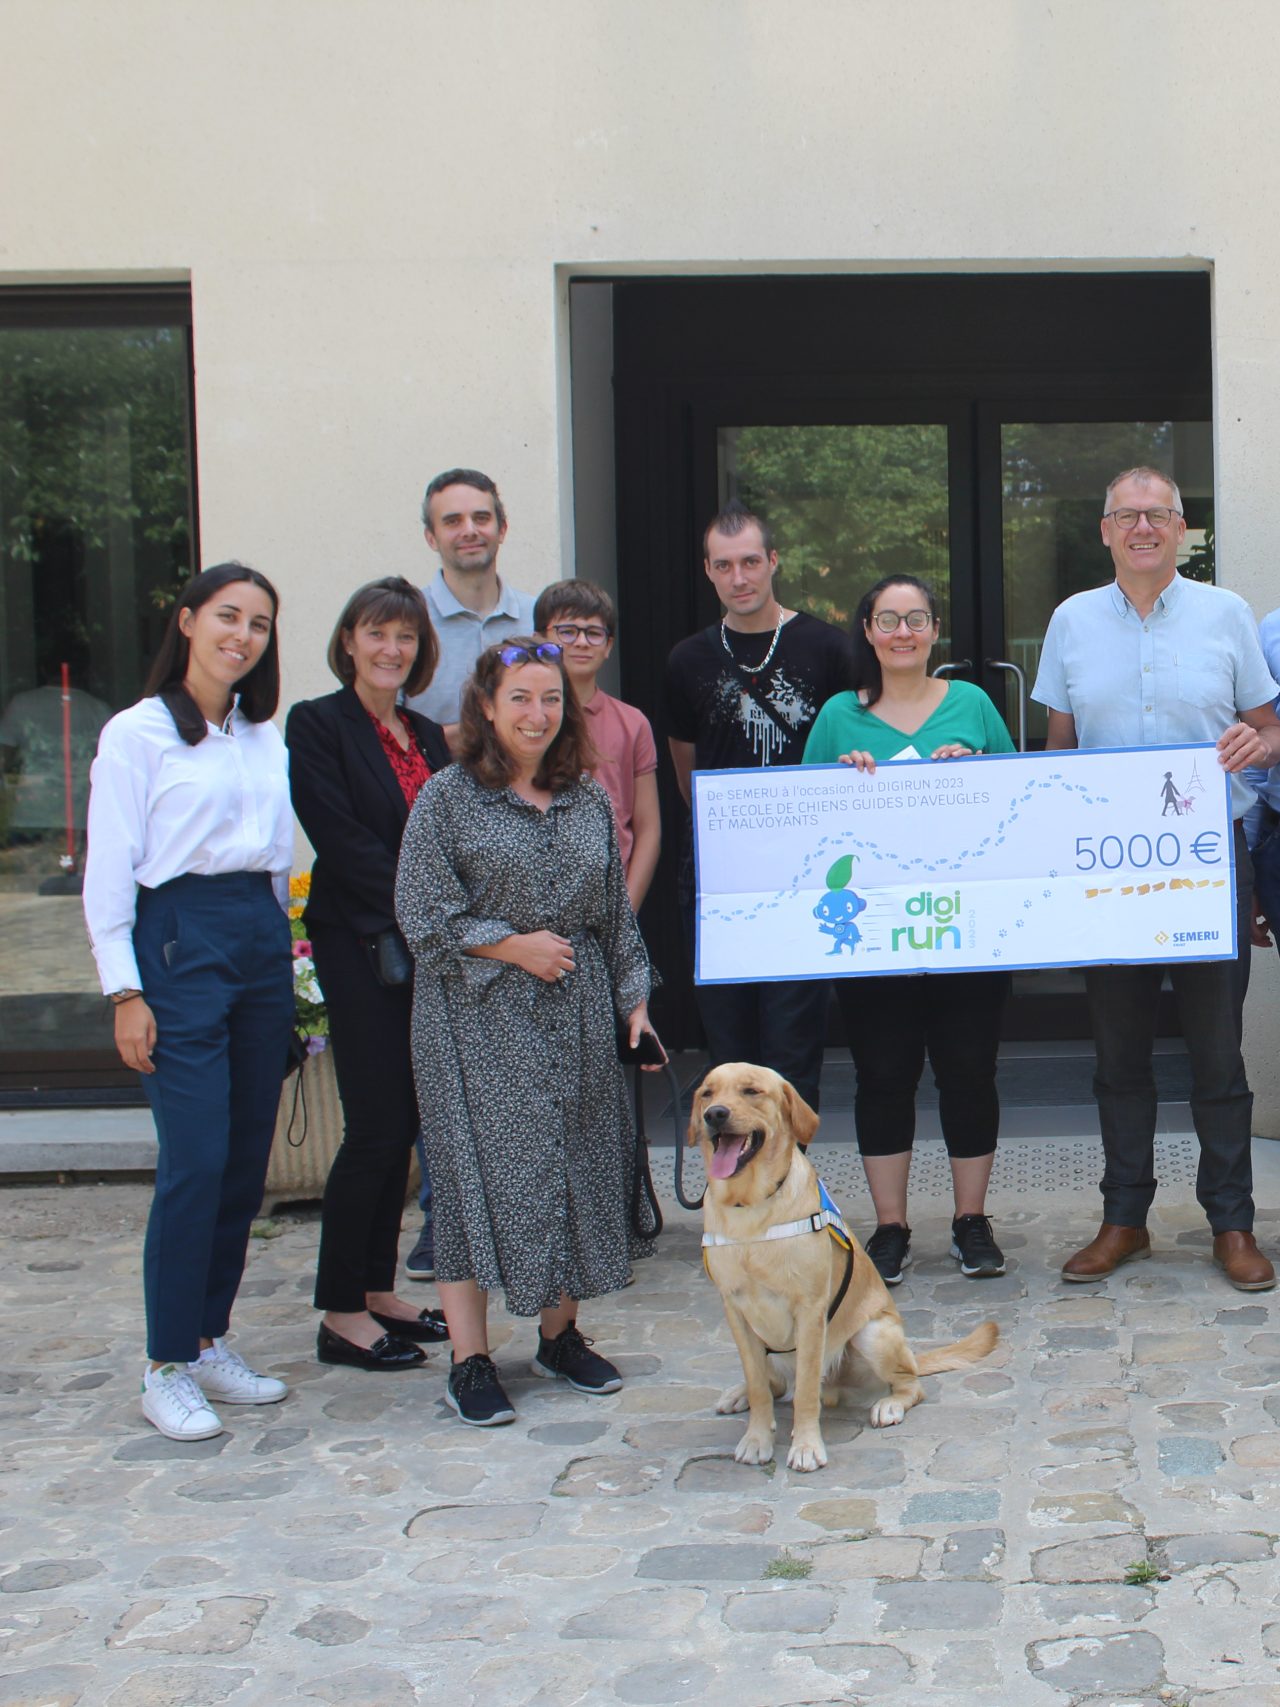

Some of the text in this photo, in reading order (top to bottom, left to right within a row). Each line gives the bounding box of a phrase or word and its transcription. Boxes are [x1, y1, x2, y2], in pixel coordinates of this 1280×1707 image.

[707, 777, 964, 801] De SEMERU à l'occasion du DIGIRUN 2023
[707, 791, 990, 818] A L'ECOLE DE CHIENS GUIDES D'AVEUGLES
[708, 814, 819, 831] ET MALVOYANTS
[1075, 830, 1222, 871] 5000 €
[905, 890, 961, 924] digi
[891, 925, 961, 952] run
[1172, 930, 1219, 943] SEMERU
